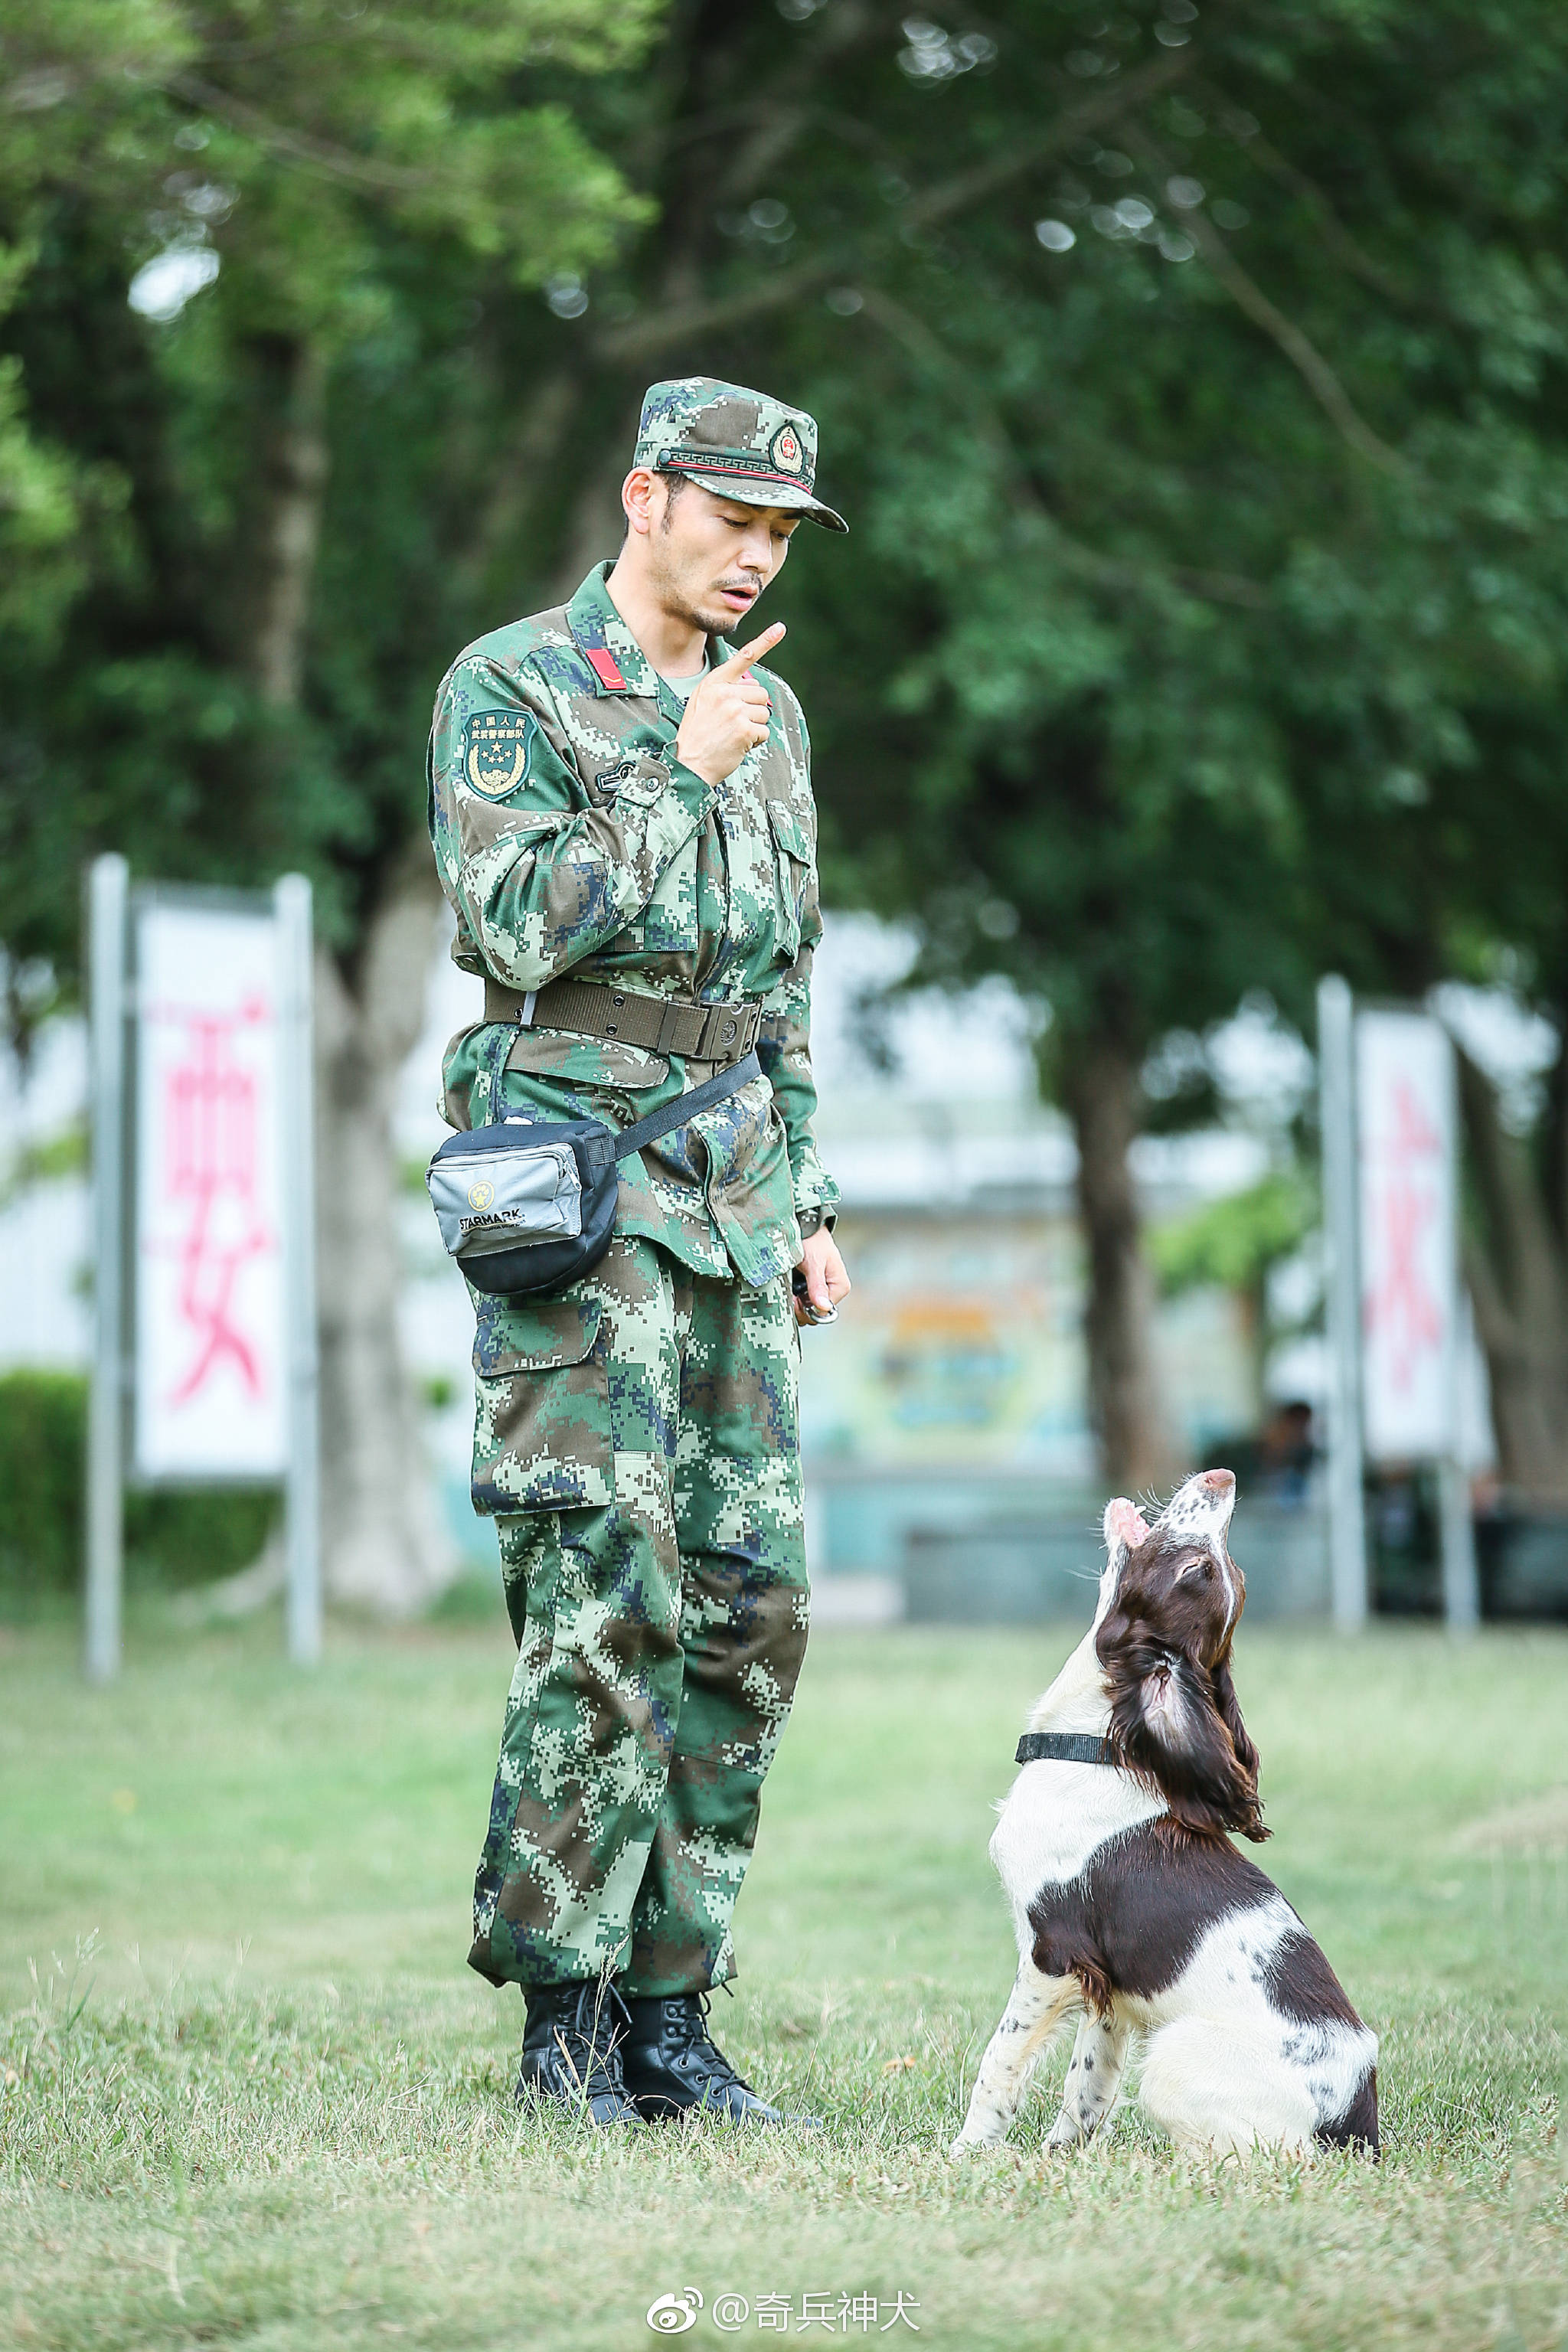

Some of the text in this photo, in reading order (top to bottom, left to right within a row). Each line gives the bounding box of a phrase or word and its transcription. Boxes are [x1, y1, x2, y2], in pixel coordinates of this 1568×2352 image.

[472, 716, 526, 729] 中国人民
[471, 730, 524, 740] 武装警察部队
